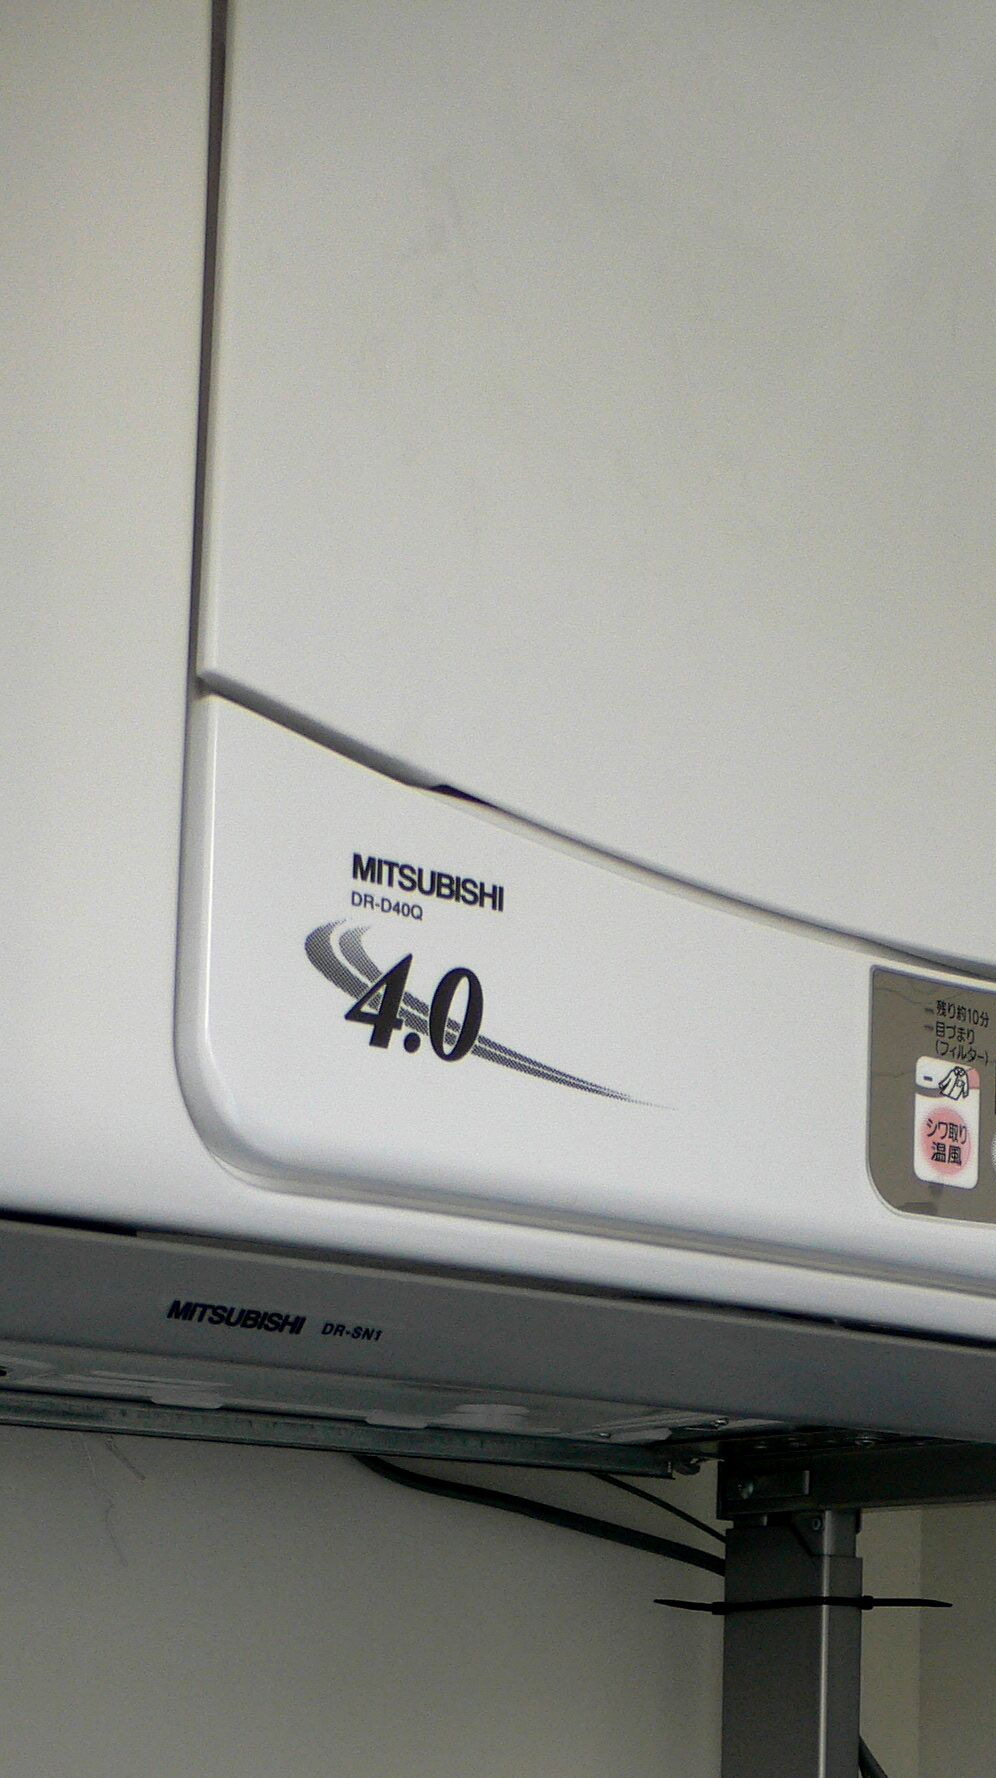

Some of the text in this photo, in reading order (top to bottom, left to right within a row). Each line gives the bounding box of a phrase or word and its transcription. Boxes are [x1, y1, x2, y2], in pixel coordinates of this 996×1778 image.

[353, 852, 504, 912] MITSUBISHI
[351, 891, 423, 920] DR-D40Q
[344, 953, 484, 1062] 4.0
[936, 1000, 990, 1028] 残り約10分
[935, 1021, 975, 1044] 目づまり
[935, 1040, 989, 1066] (フィルター)
[926, 1118, 967, 1144] シワ取り
[931, 1141, 962, 1166] 温風
[167, 1300, 383, 1341] MITSUBISHI DR-SN1
